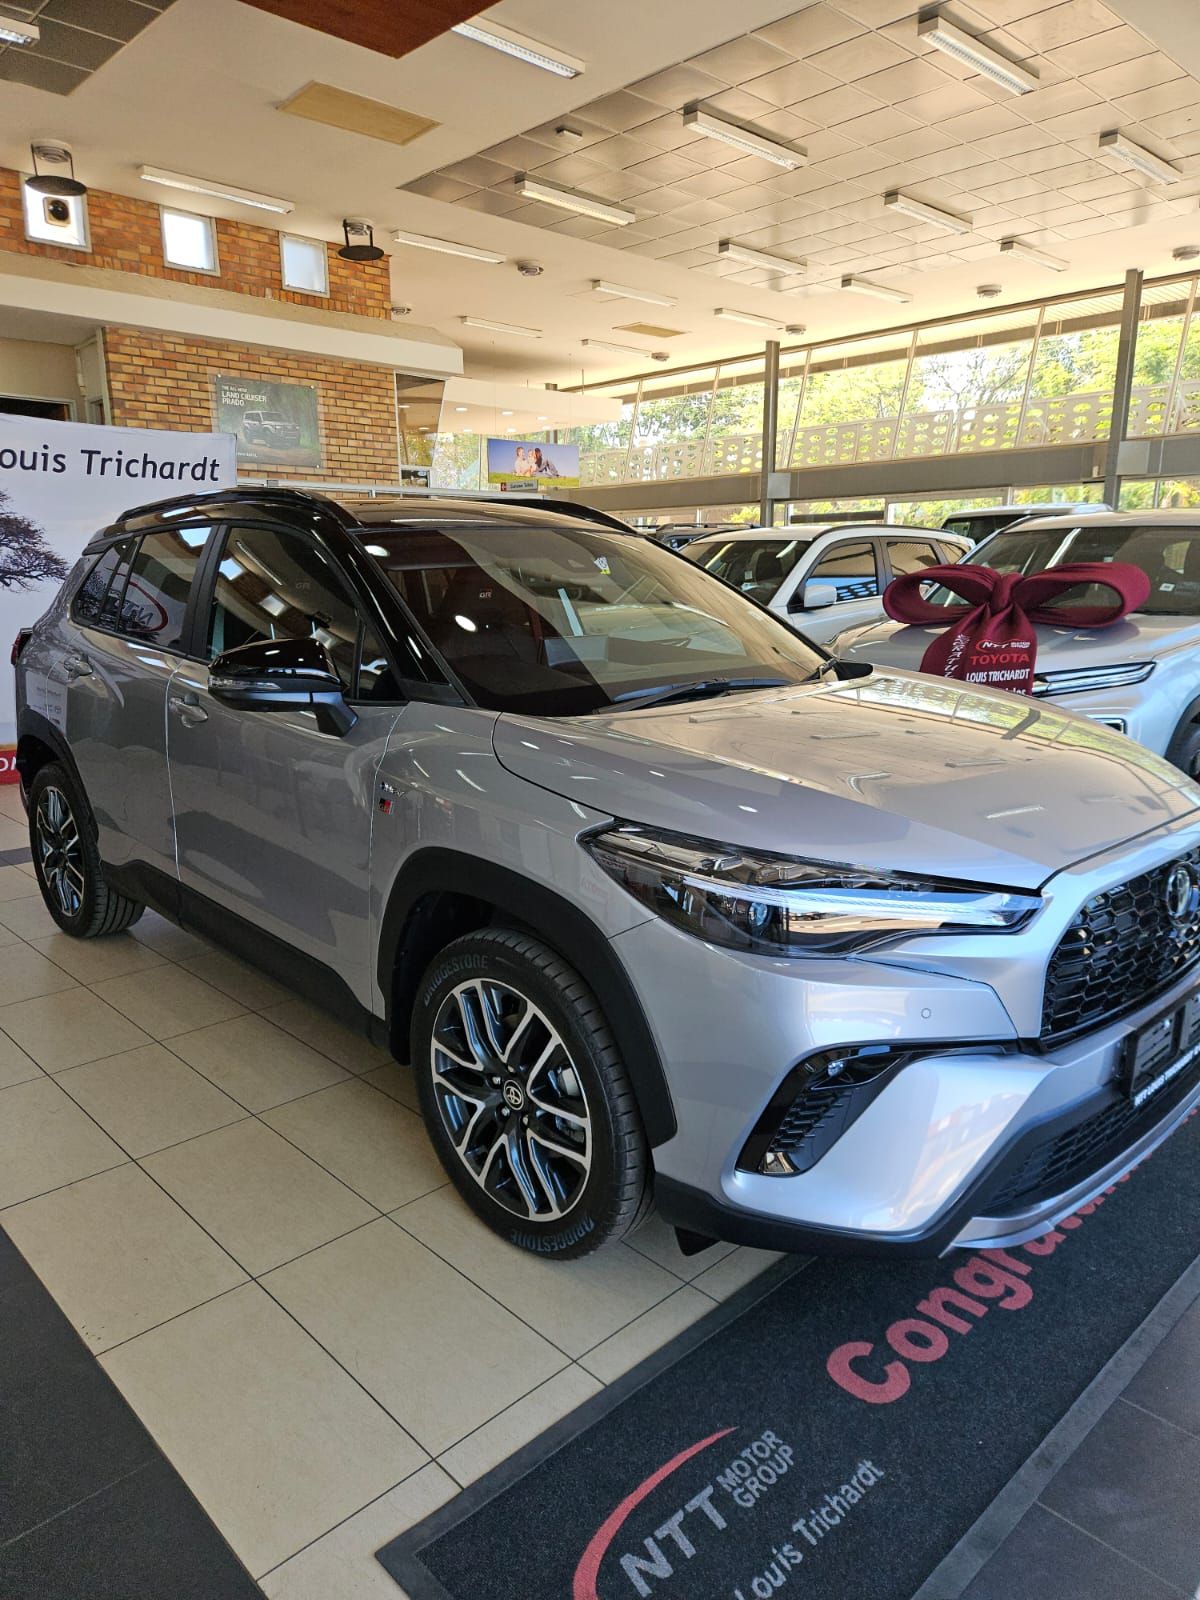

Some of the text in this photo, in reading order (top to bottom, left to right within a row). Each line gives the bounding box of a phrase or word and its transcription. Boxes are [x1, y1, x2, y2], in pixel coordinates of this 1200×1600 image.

[222, 391, 267, 403] LAND CRUISER
[222, 398, 245, 407] PRADO
[80, 449, 220, 482] Trichardt
[970, 653, 1030, 666] TOYOTA
[966, 669, 1031, 683] LOUIS TRICHARDT
[716, 1430, 783, 1492] MOTOR
[792, 1458, 885, 1546] Trichardt
[619, 1445, 794, 1598] NTT GROUP
